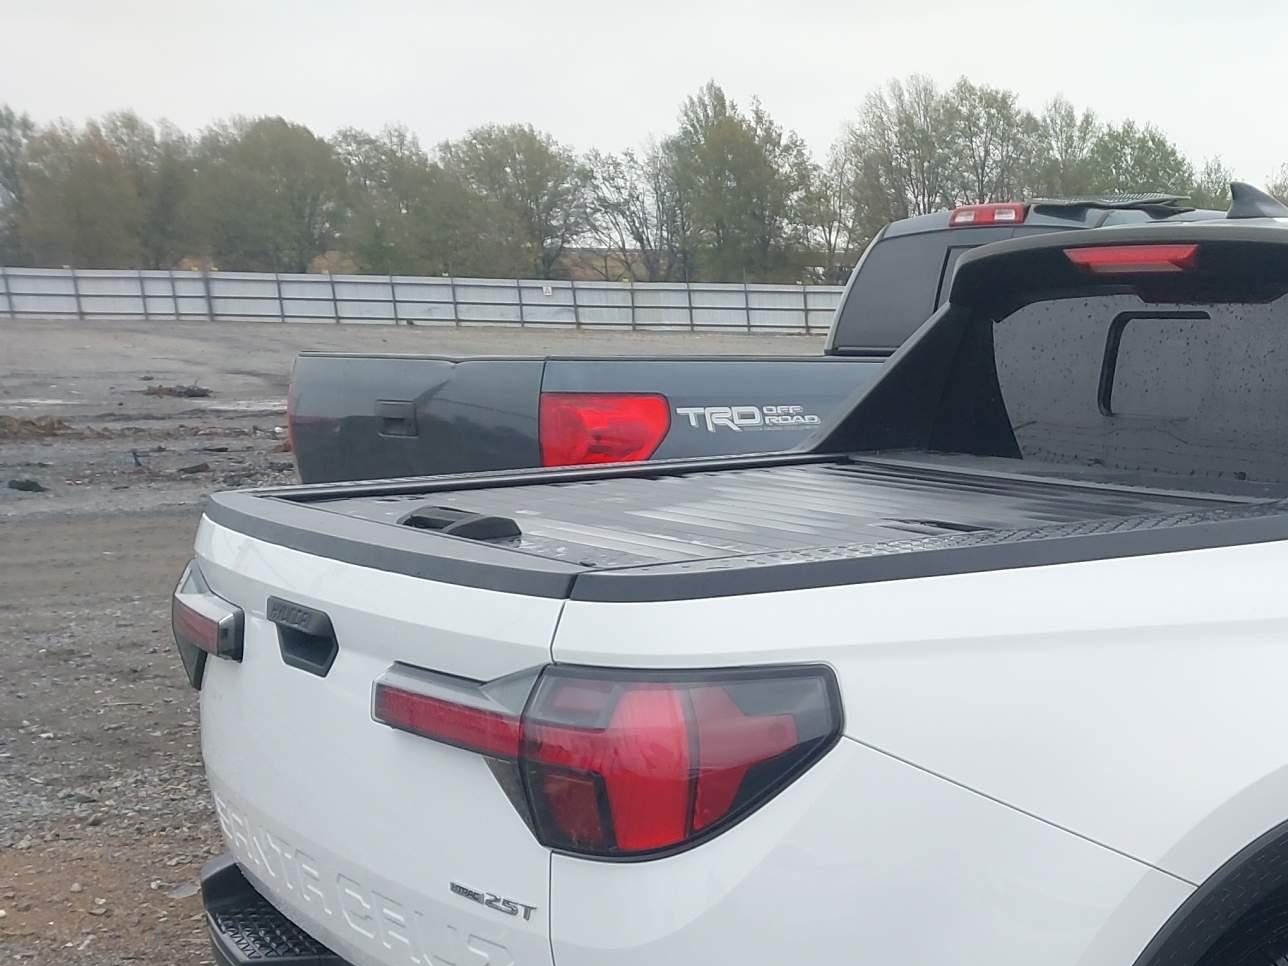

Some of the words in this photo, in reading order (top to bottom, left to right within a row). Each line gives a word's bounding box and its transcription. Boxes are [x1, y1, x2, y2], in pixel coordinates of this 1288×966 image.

[763, 405, 804, 415] OFF
[676, 405, 763, 432] TRD
[764, 415, 822, 426] ROAD
